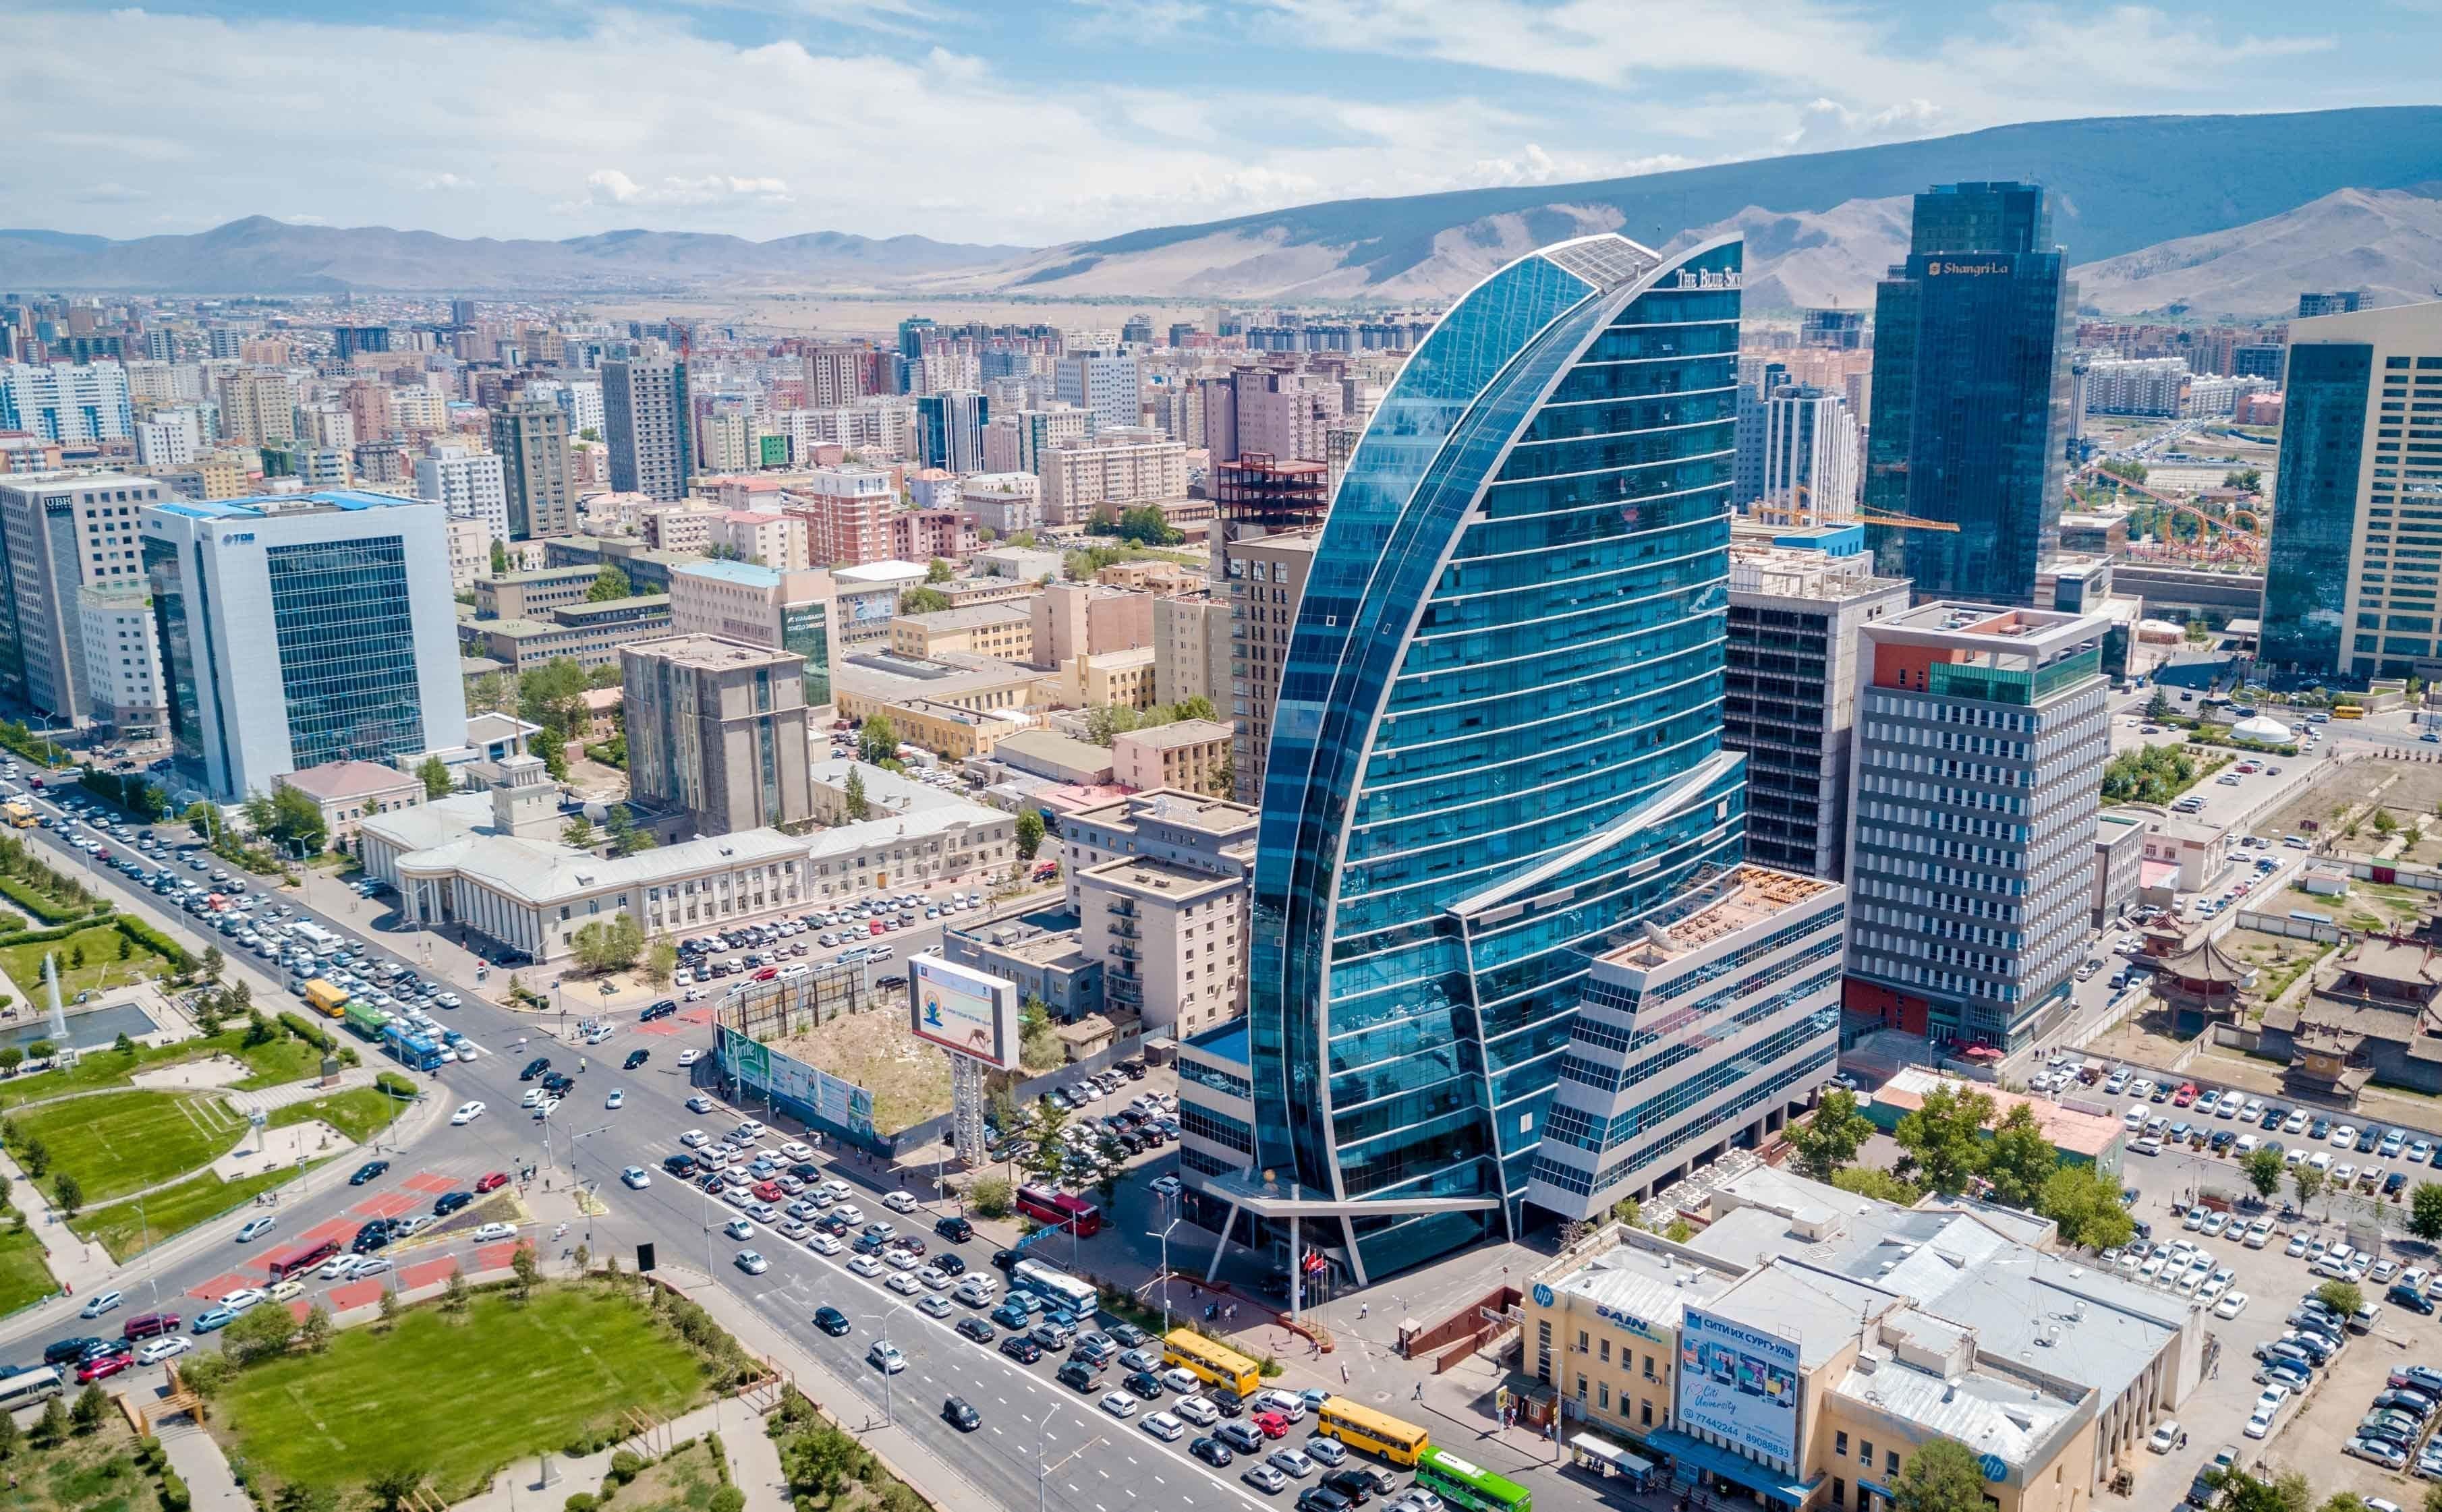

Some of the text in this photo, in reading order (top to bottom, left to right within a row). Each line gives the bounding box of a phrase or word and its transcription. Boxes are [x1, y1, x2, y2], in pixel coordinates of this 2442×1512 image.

[46, 497, 72, 506] UBH
[729, 1041, 755, 1057] Sprite
[1596, 1305, 1647, 1331] SAIN
[1704, 1319, 1729, 1335] СИТИ
[1731, 1328, 1744, 1339] ИХ
[1745, 1334, 1794, 1359] СУРГУУЛЬ
[1703, 1385, 1719, 1397] Citi
[1695, 1395, 1737, 1415] University
[1695, 1413, 1738, 1437] 77442244
